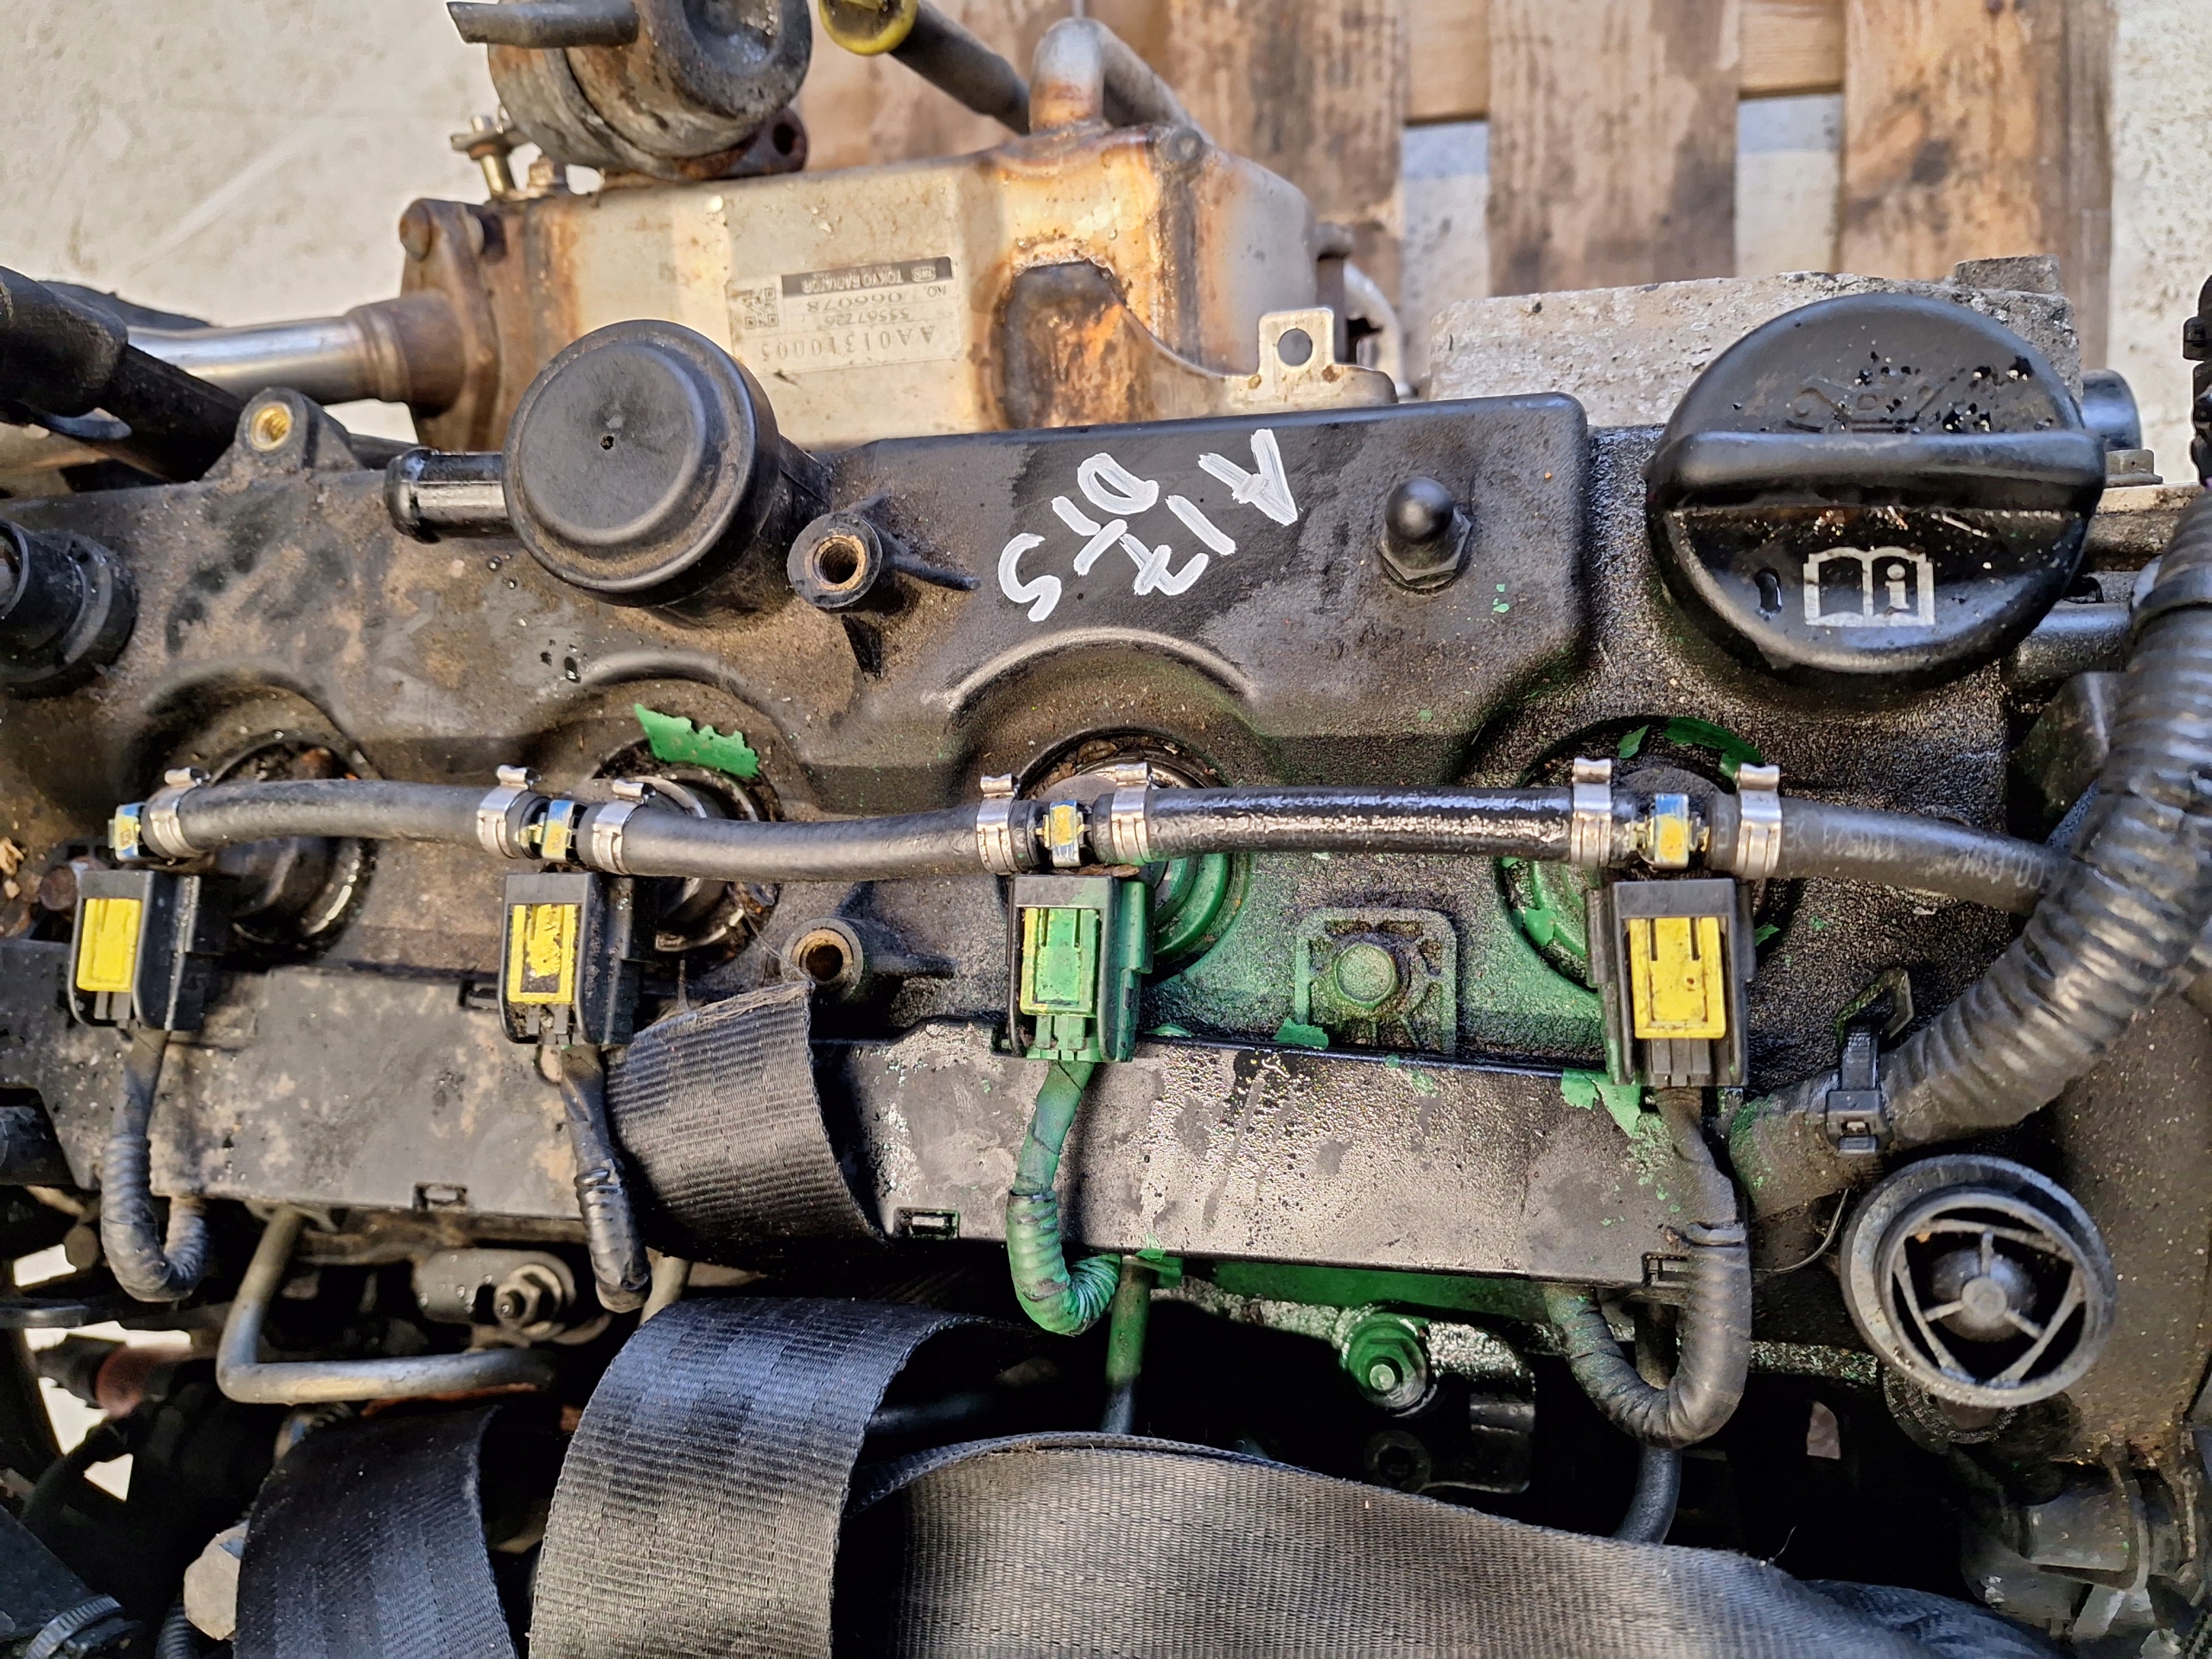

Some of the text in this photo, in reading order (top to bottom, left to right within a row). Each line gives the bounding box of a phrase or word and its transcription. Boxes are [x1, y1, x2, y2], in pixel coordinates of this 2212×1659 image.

[863, 270, 904, 287] TOKYO
[806, 291, 903, 313] 066078
[761, 324, 936, 362] AA01310005
